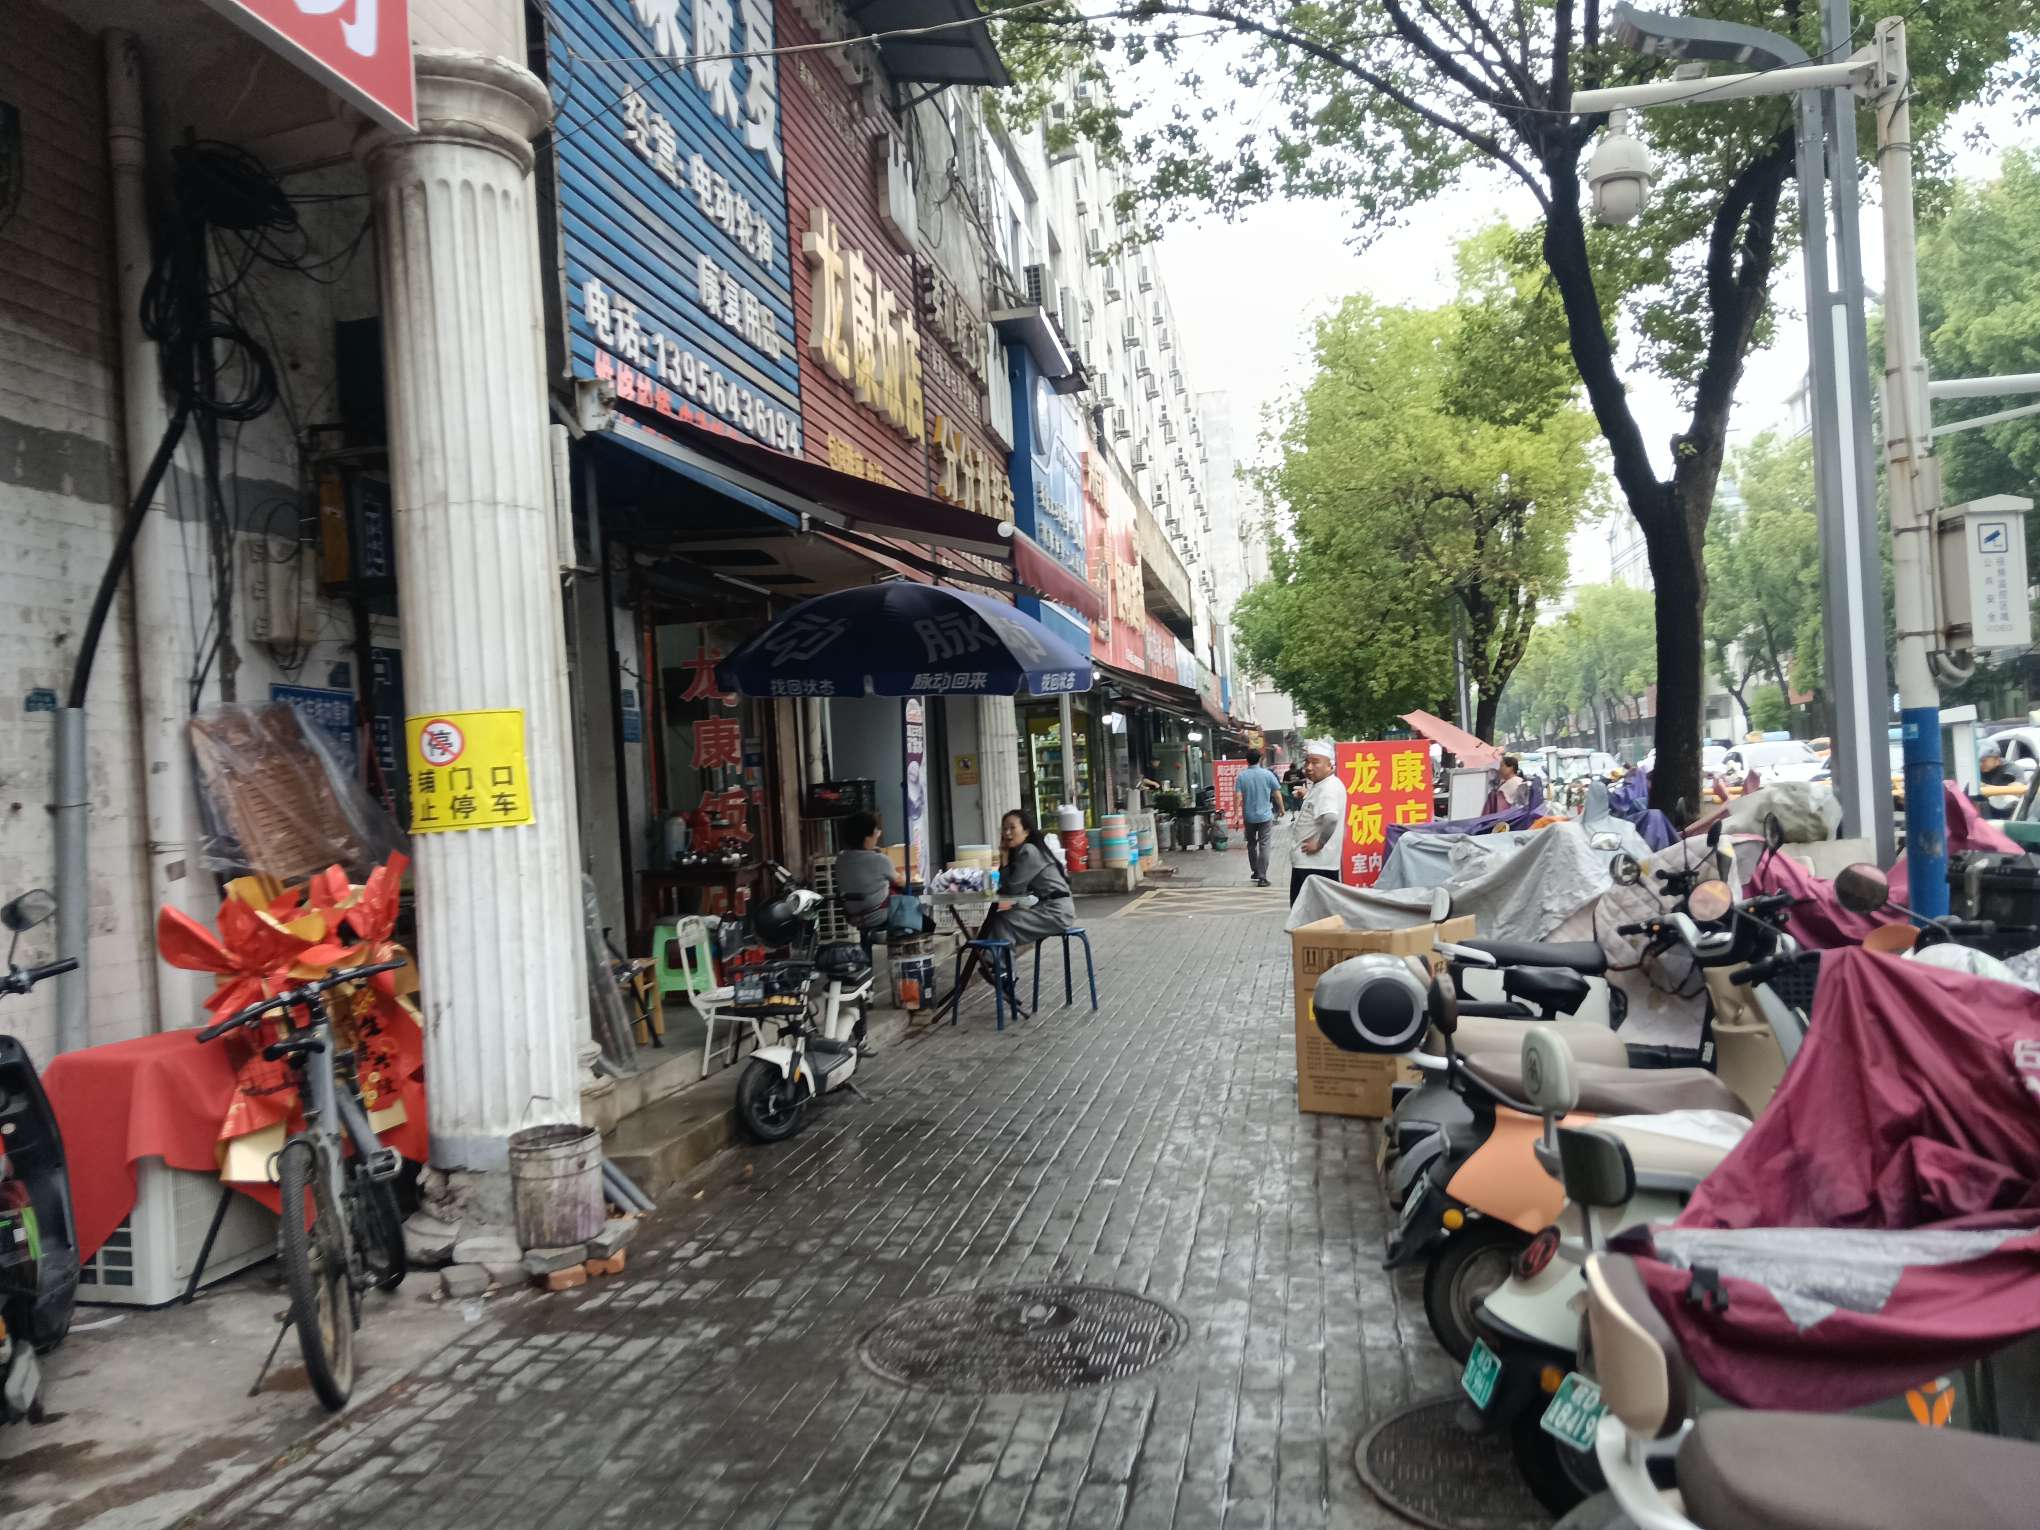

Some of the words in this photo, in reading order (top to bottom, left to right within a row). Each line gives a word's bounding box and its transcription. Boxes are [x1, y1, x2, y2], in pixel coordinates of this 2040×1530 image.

[697, 253, 782, 361] 康复用品
[803, 206, 926, 447] 龙康饭店
[769, 678, 836, 697] 找回状态
[910, 671, 989, 694] 脉动回来
[1344, 750, 1427, 795] 龙康
[410, 791, 518, 822] 止停车
[1347, 799, 1428, 847] 饭店
[1351, 852, 1382, 874] 室内
